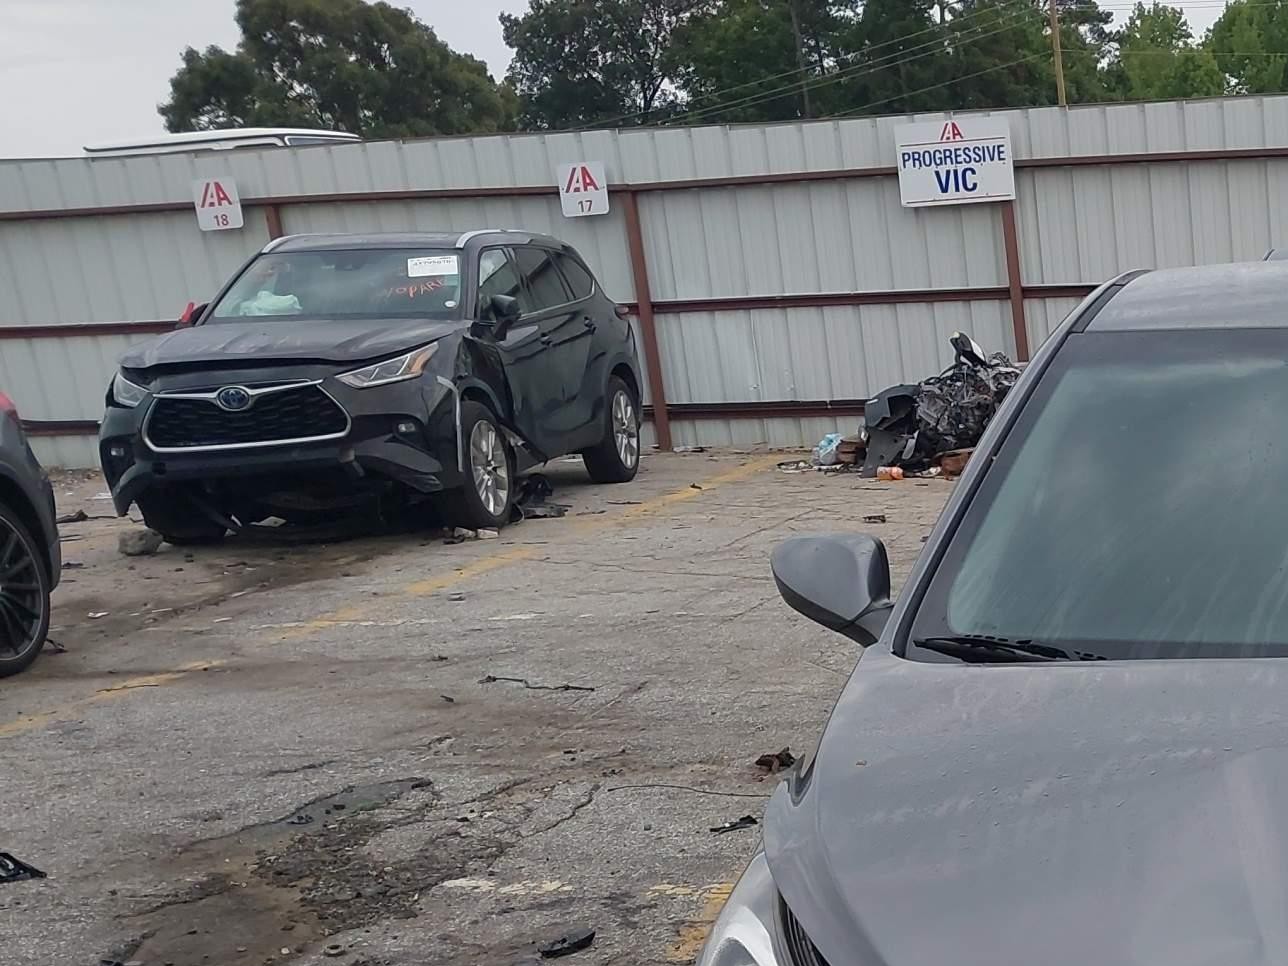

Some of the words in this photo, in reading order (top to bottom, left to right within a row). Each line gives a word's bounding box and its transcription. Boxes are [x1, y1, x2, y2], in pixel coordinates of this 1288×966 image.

[901, 144, 1006, 169] PROGRESSIVE
[934, 167, 978, 194] VIC
[577, 200, 593, 213] 17
[213, 214, 229, 226] 18
